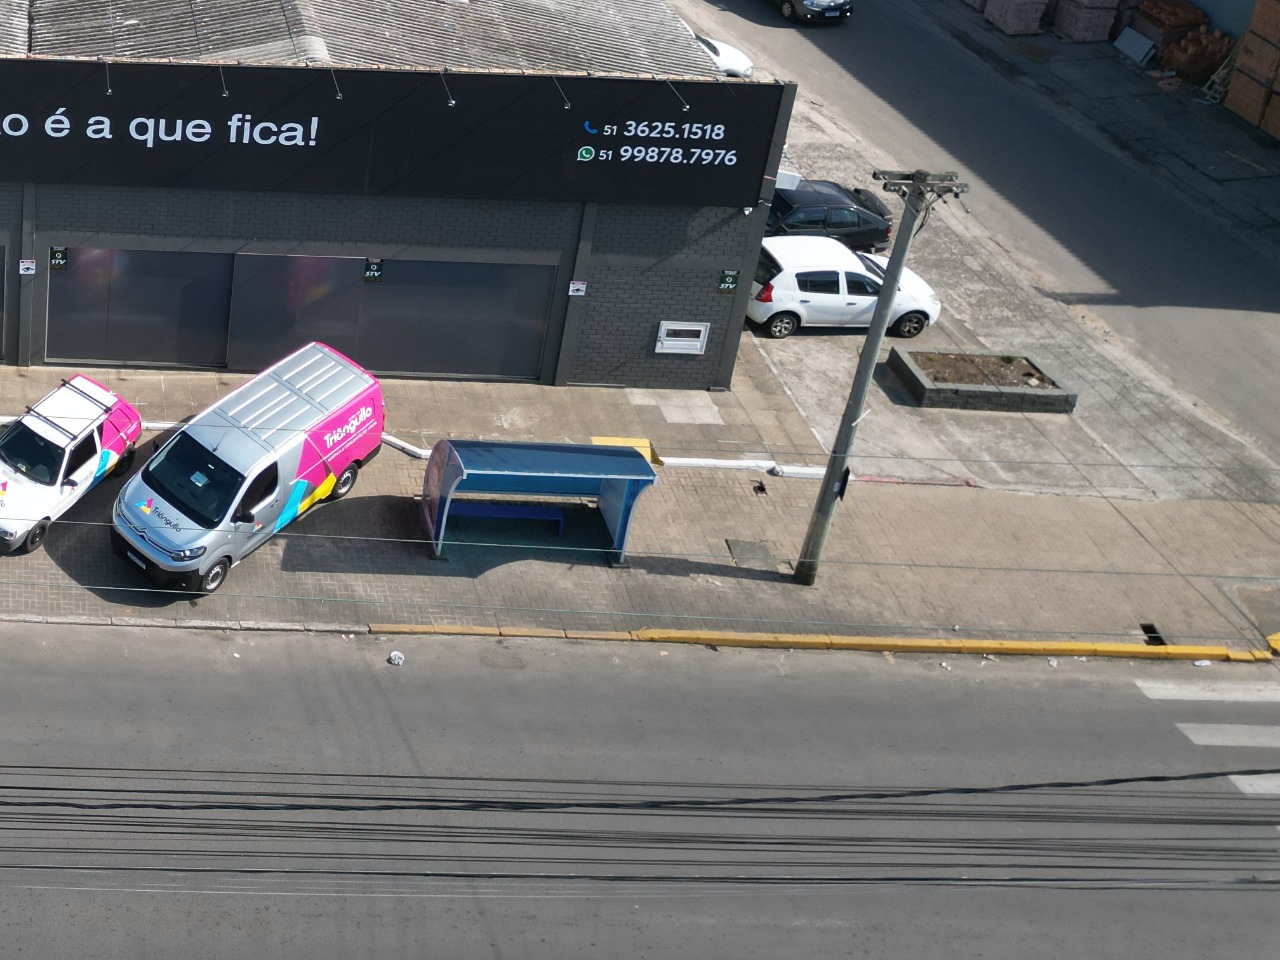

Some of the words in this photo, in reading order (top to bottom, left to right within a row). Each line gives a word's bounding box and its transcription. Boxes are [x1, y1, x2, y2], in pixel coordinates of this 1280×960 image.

[44, 107, 71, 138] é
[85, 115, 113, 139] a
[128, 117, 212, 148] que
[227, 113, 319, 146] fica!
[603, 124, 618, 136] 51
[623, 120, 725, 140] 3625.1518
[598, 149, 613, 161] 51
[619, 145, 737, 166] 99878.7976
